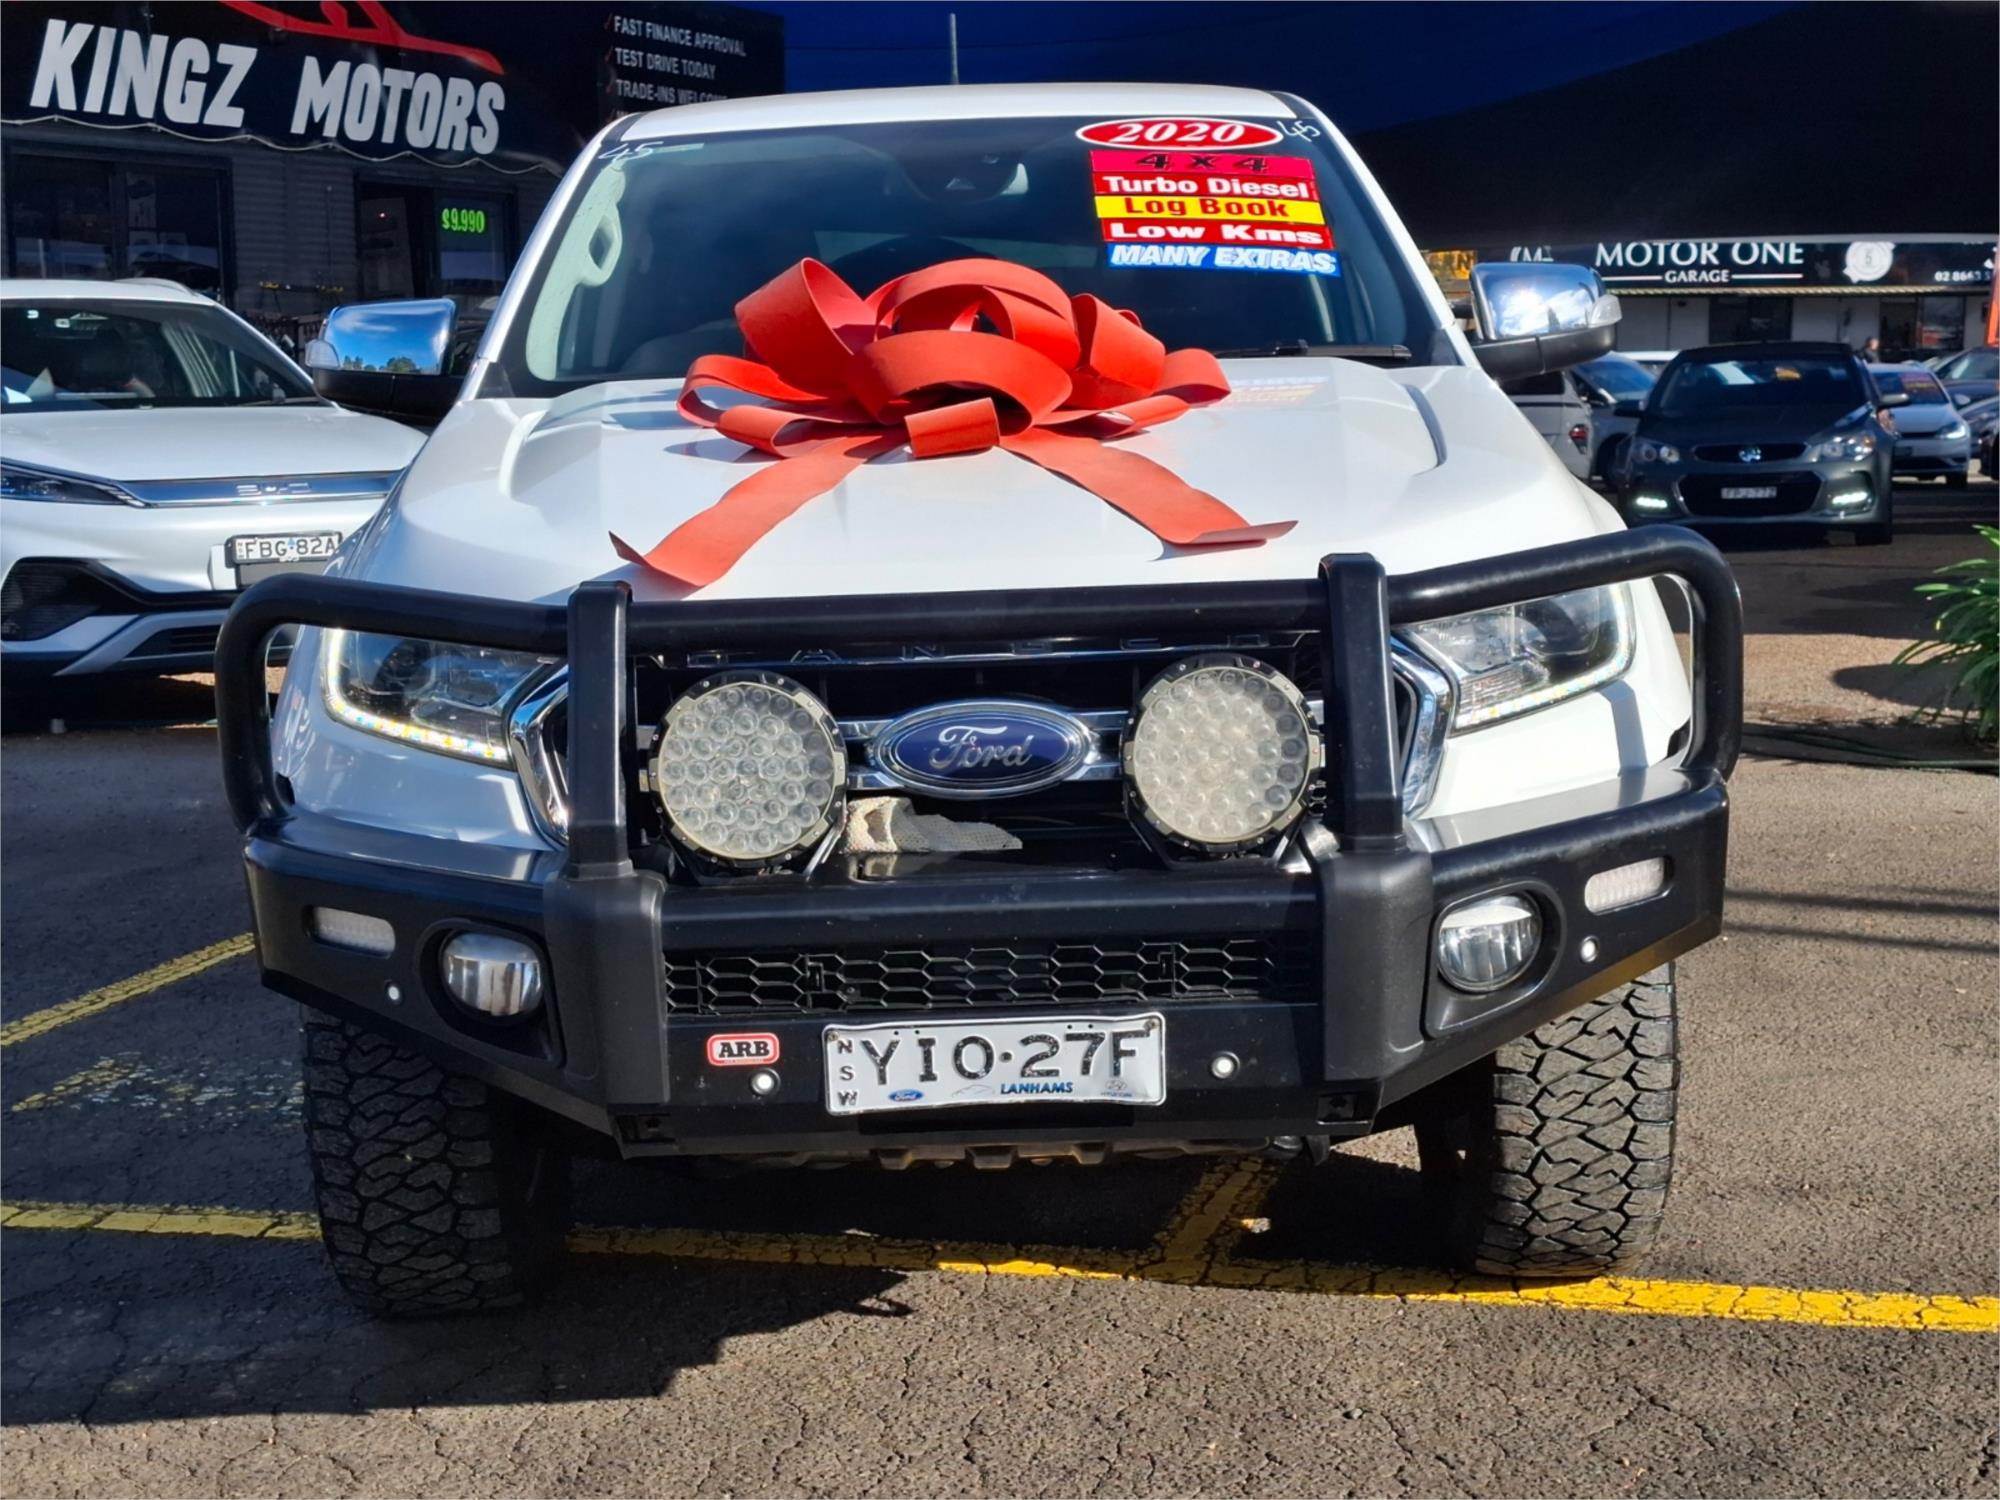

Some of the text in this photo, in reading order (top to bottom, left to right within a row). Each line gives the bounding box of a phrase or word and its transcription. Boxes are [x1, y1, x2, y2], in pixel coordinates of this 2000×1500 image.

[614, 15, 747, 56] FAST FINANCE APPROVAL
[615, 47, 716, 80] TEST DRIVE TODAY
[30, 18, 505, 155] KINGZ MOTORS
[616, 79, 675, 104] TRADE-INS
[1107, 122, 1246, 143] 2020
[598, 141, 664, 162] 45
[1102, 176, 1310, 198] Turbo Diesel
[1124, 197, 1289, 217] Log Book
[1110, 223, 1324, 244] Low Kms
[1110, 244, 1337, 274] MANY EXTRAS
[1595, 241, 1804, 267] MOTOR ONE
[1664, 269, 1730, 283] GARAGE
[1934, 270, 1950, 282] 02
[928, 725, 1035, 770] Ford
[718, 1040, 770, 1058] ARB
[1000, 1082, 1074, 1095] LANHAMS
